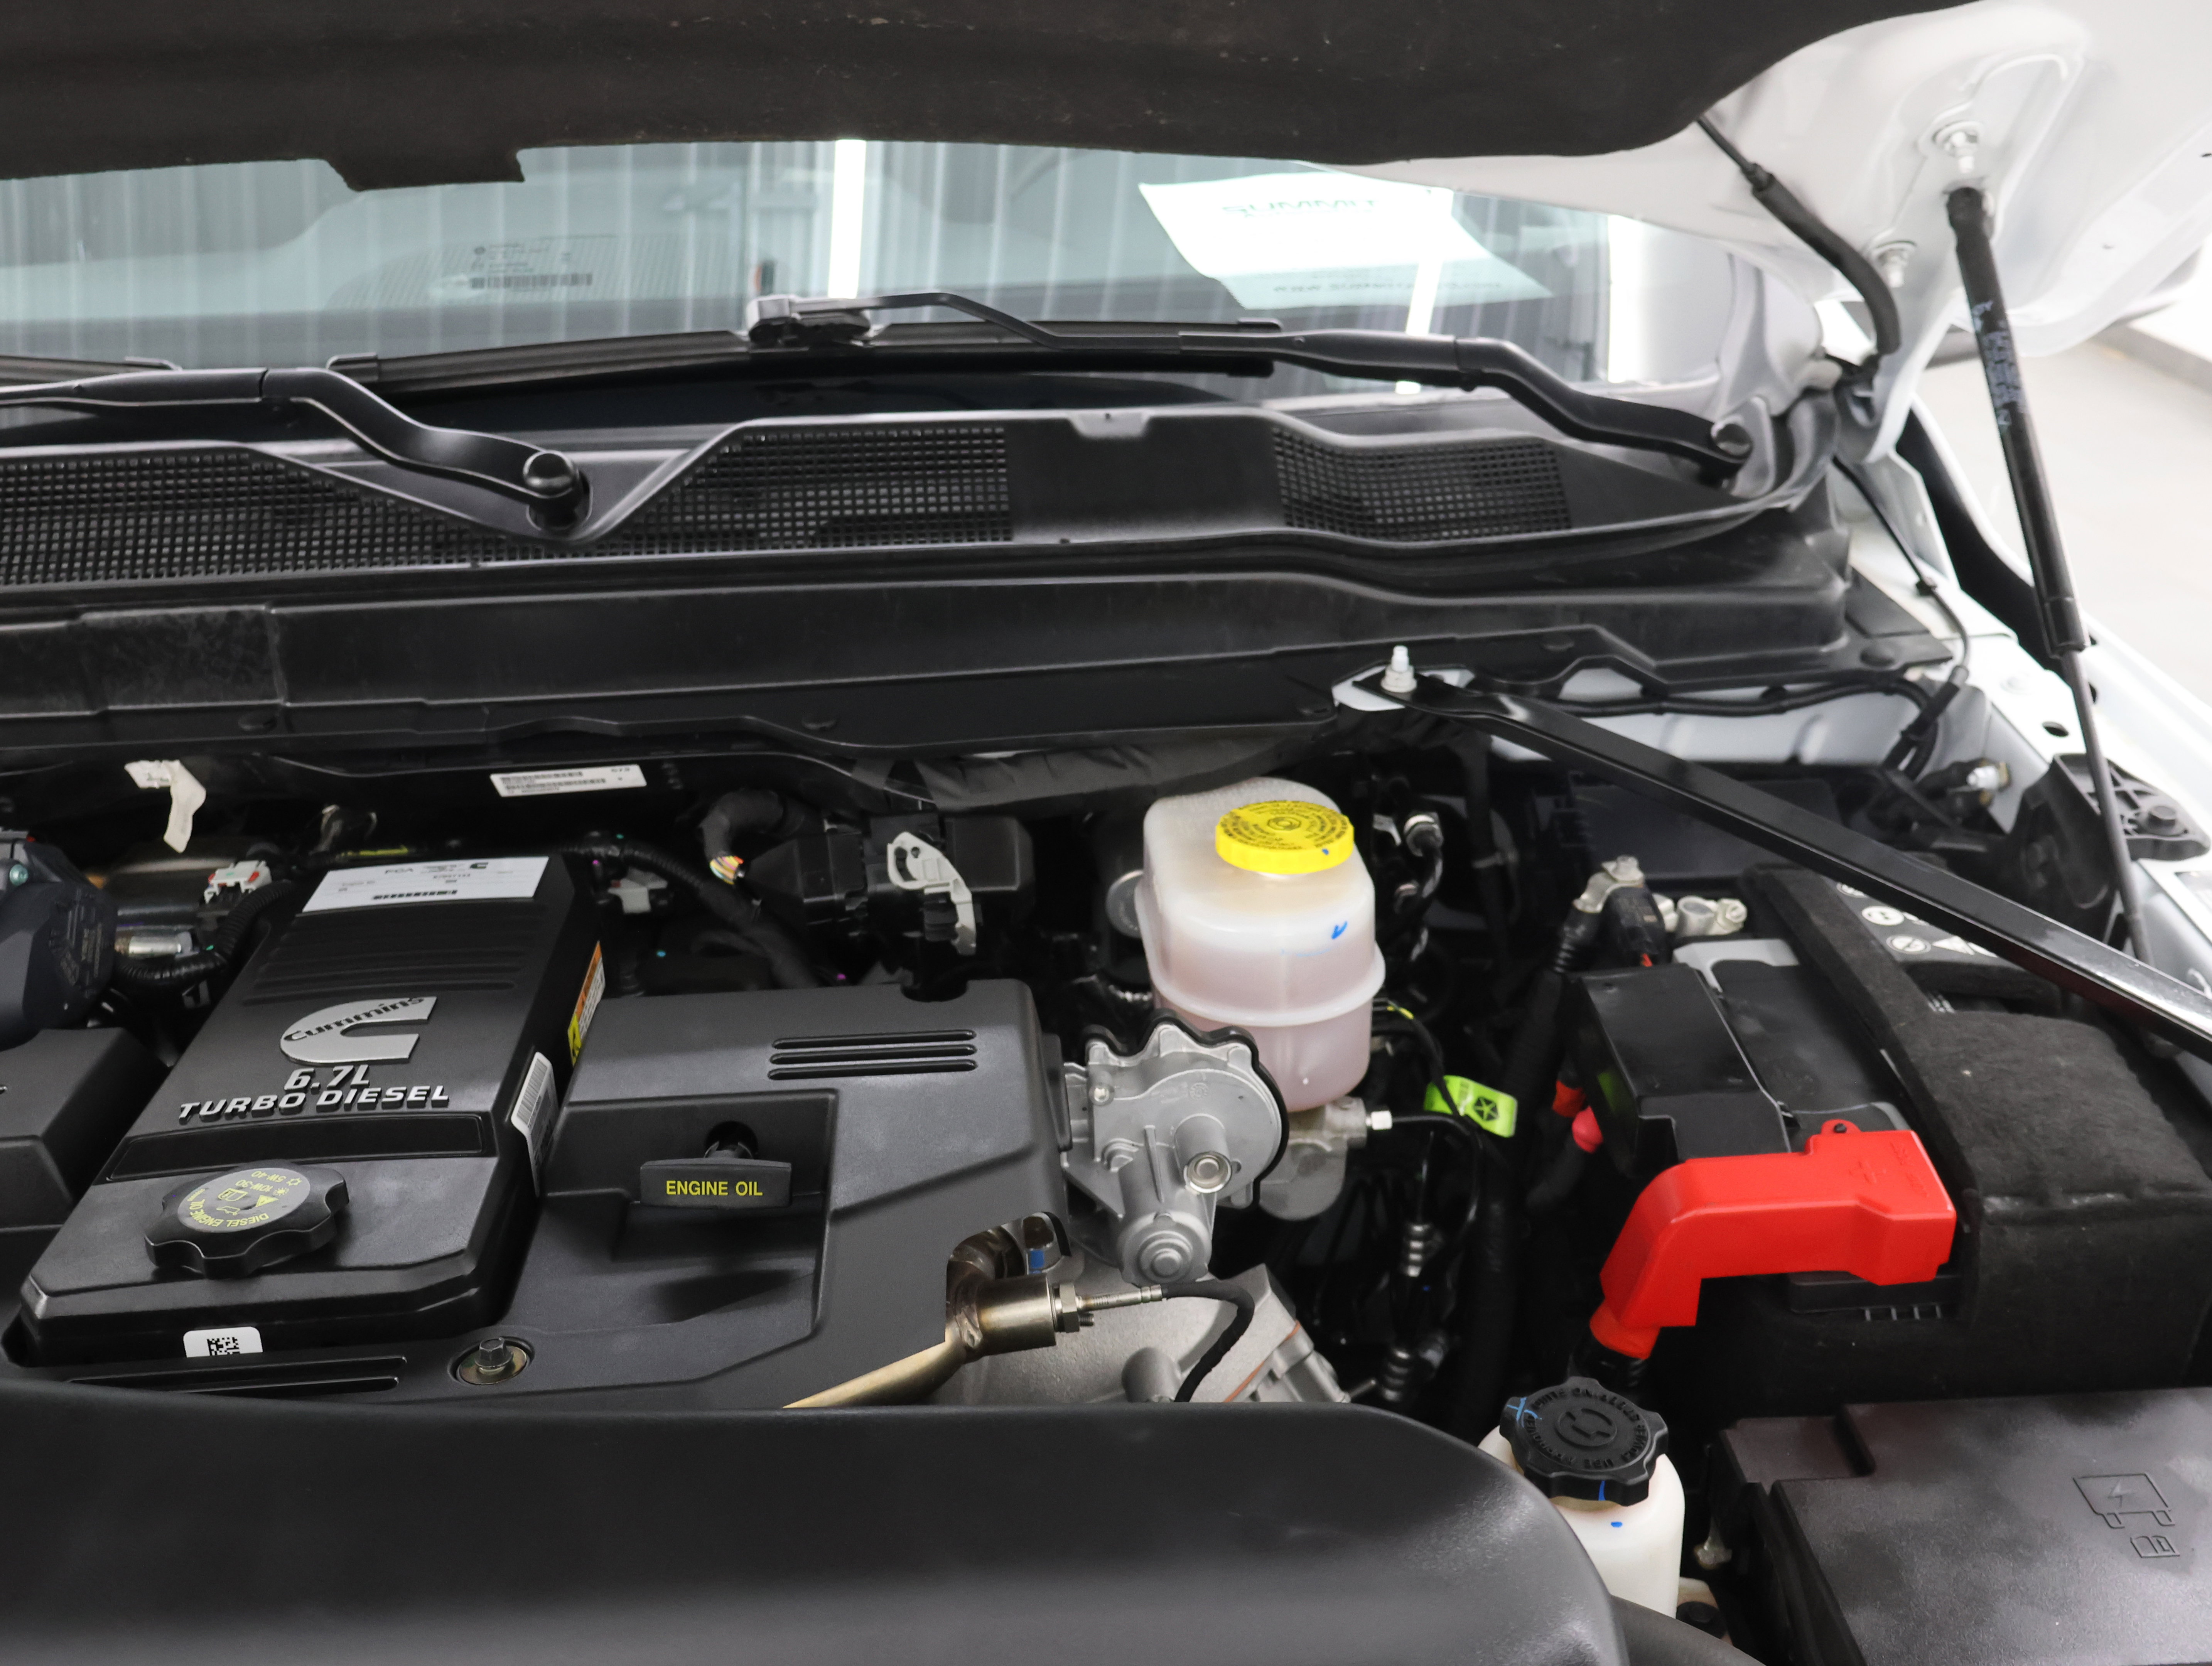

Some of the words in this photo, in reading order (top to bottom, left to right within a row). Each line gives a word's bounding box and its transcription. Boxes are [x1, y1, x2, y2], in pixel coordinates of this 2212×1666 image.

[283, 997, 425, 1041] Cummins
[284, 1064, 370, 1092] 6.7L
[179, 1092, 307, 1121] TURBO
[316, 1085, 450, 1111] DIESEL
[251, 1170, 287, 1182] 5W-40
[235, 1179, 273, 1193] 10W-30
[666, 1180, 729, 1196] ENGINE
[735, 1180, 764, 1196] OIL
[189, 1198, 206, 1210] OIL
[190, 1209, 224, 1227] ENGINE
[226, 1212, 270, 1228] DIESEL
